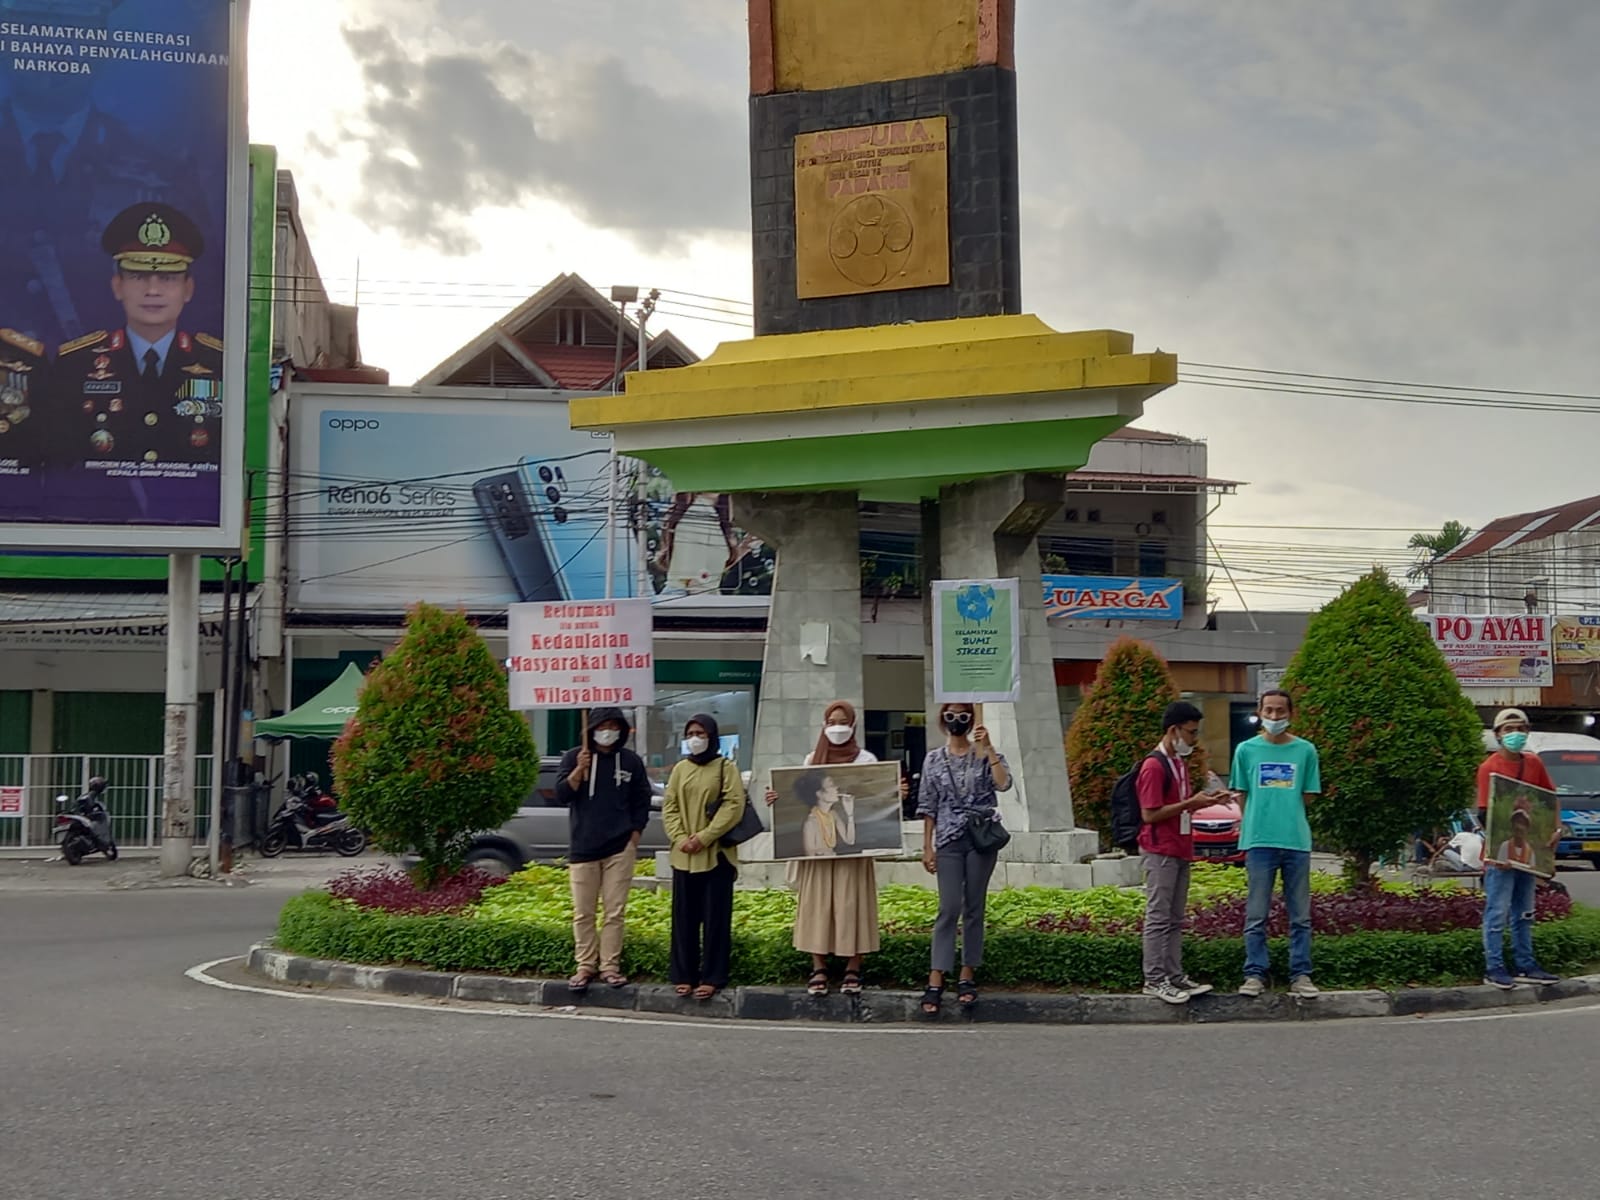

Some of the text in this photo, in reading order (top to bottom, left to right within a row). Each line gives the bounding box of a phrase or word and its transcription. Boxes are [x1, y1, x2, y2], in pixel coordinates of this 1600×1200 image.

[1, 22, 191, 46] SELAMATKAN GENERASI
[10, 40, 74, 56] BAHAYA
[79, 45, 229, 66] PENYALAHGUNAAN
[14, 58, 91, 75] NARKOBA
[328, 418, 380, 432] oppo
[327, 485, 457, 506] Reno6 Series
[543, 603, 616, 618] Reformasi
[1436, 617, 1545, 641] PO AYAH
[531, 632, 629, 650] Kedaulatan
[962, 637, 991, 645] BUMI
[510, 652, 651, 673] Masyarakat Adat
[534, 686, 633, 704] Wilayahnya
